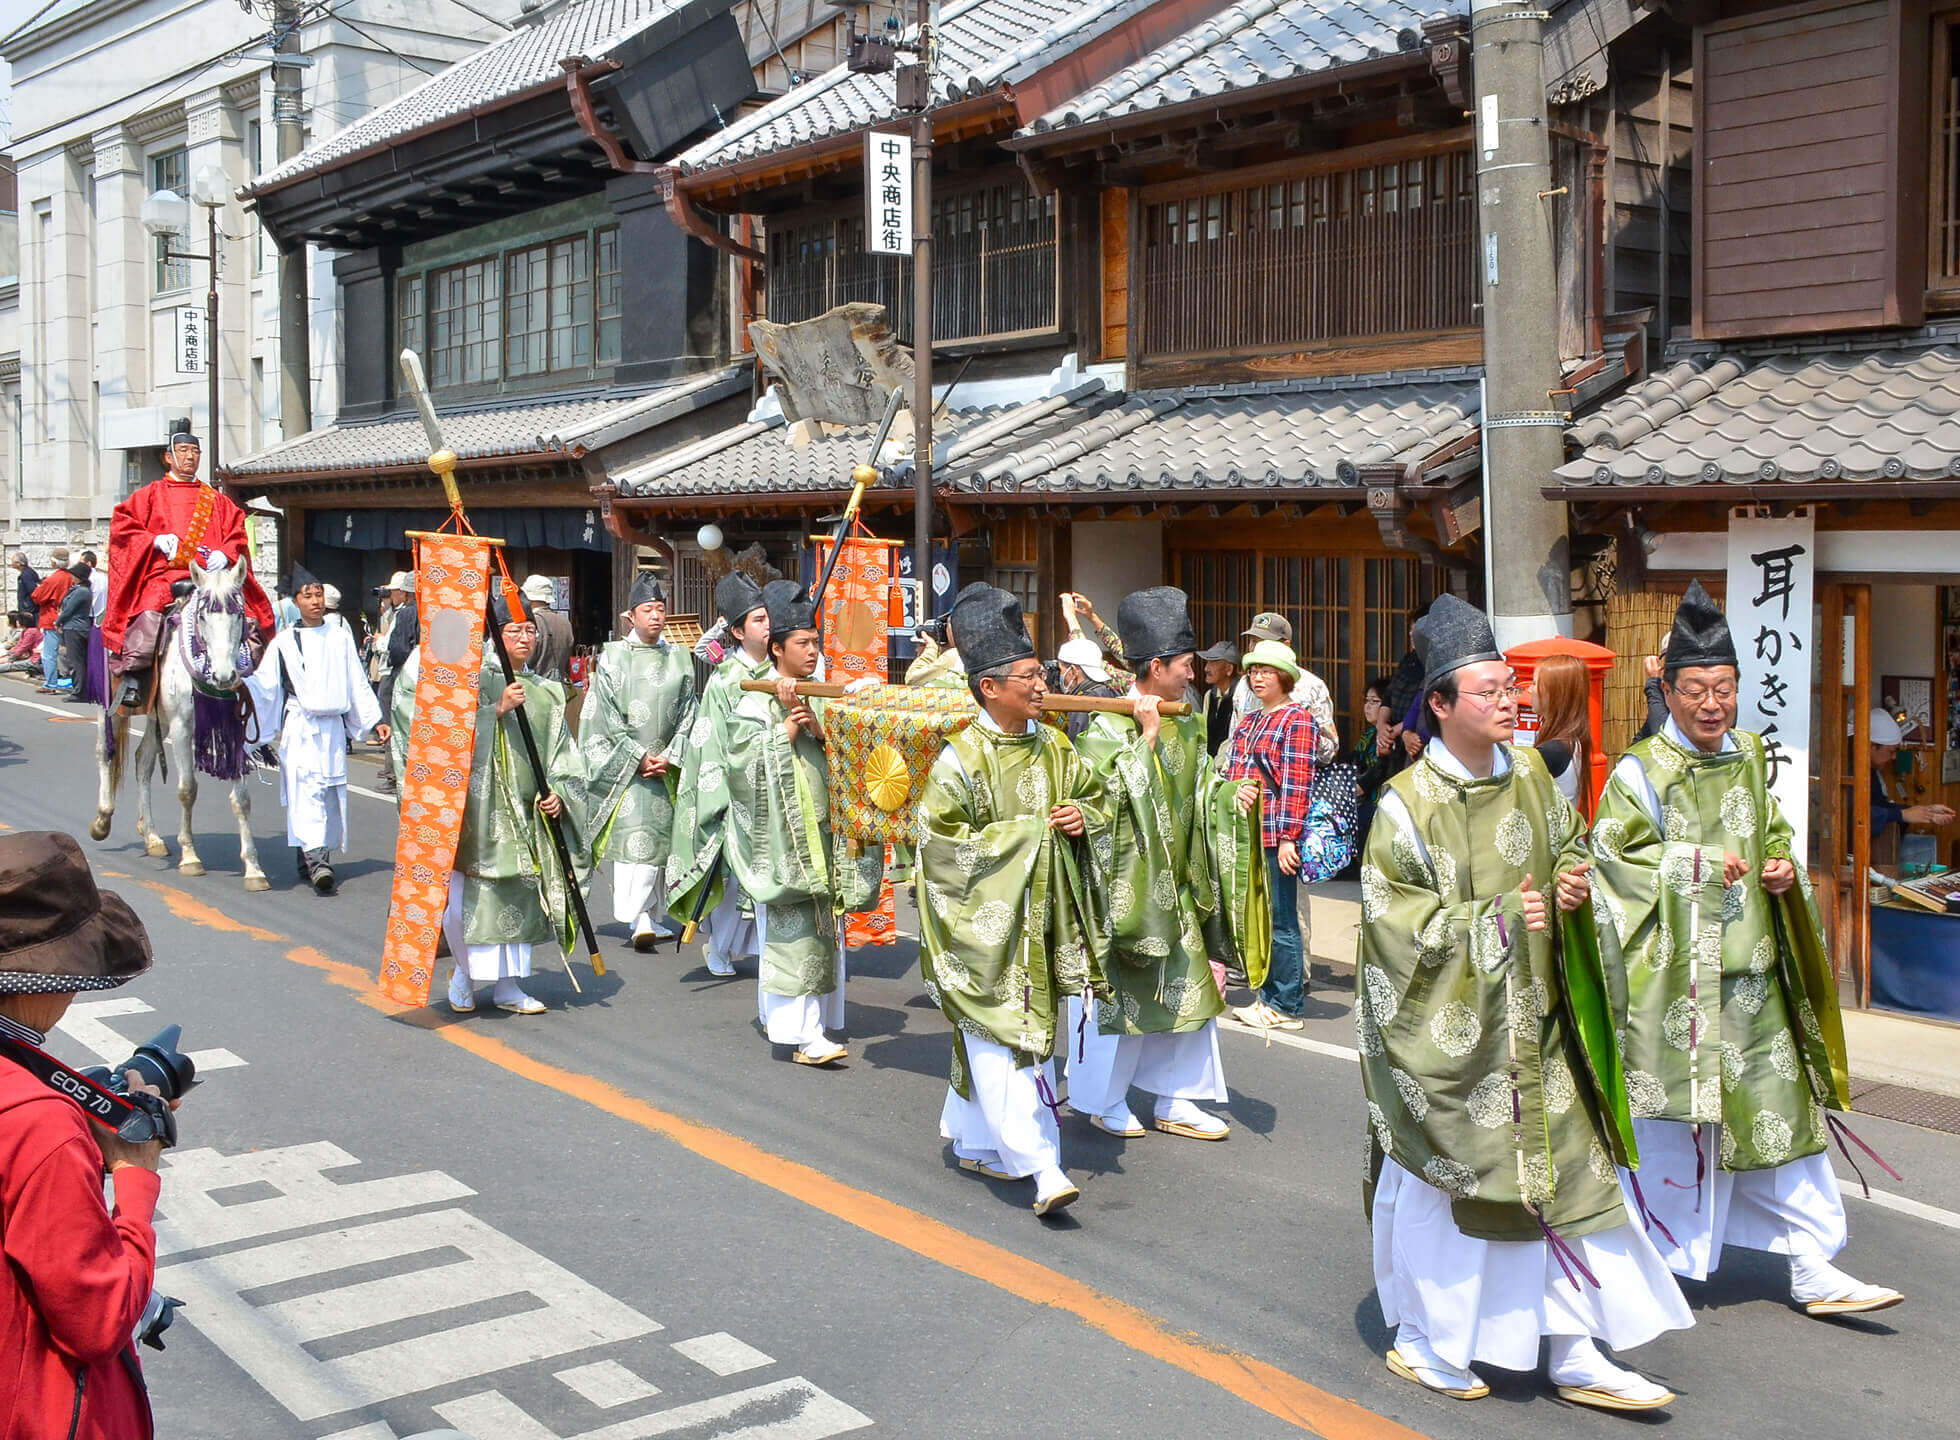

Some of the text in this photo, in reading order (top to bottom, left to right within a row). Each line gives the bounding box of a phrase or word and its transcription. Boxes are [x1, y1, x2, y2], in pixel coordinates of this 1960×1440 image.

[881, 139, 902, 251] 中央商店街
[184, 310, 198, 371] 中央商店街
[1750, 543, 1807, 803] 耳かき手
[50, 1070, 113, 1115] EOS 7D
